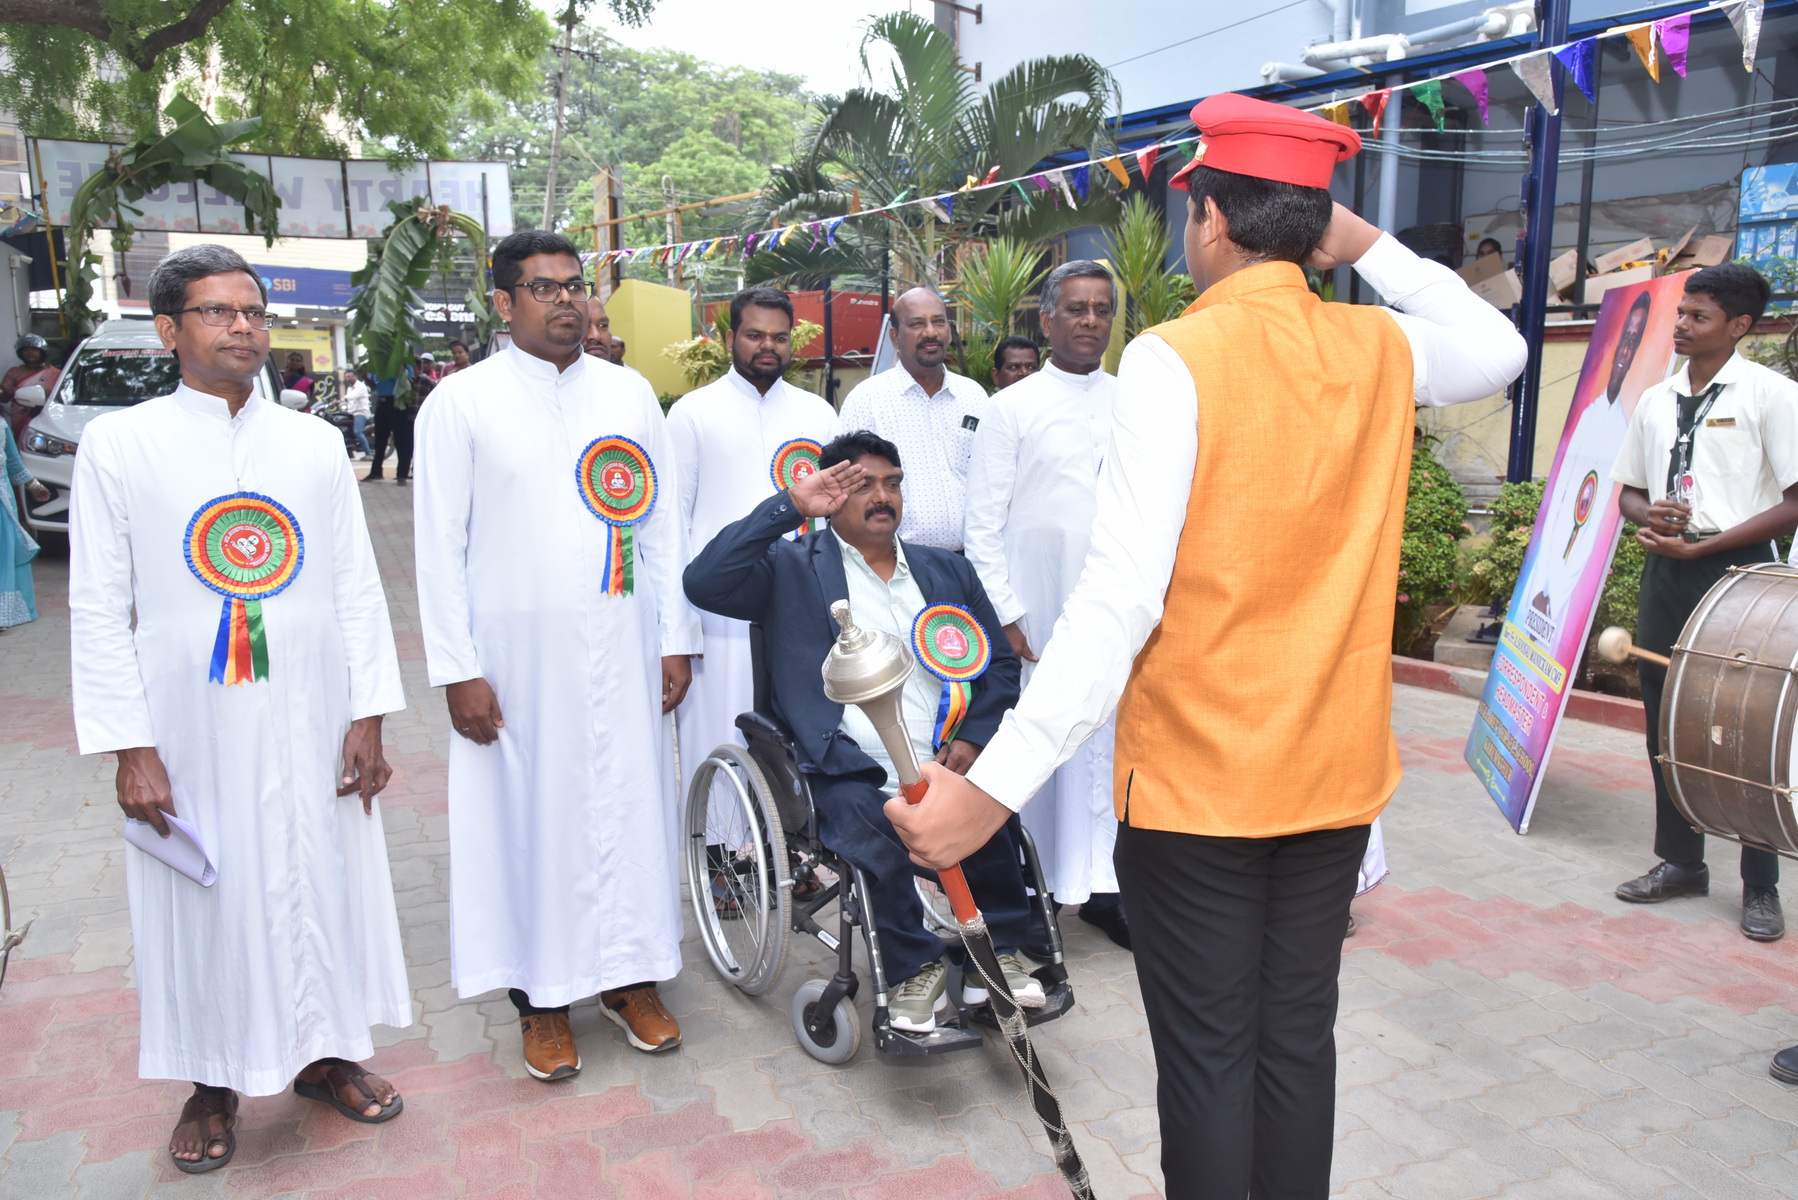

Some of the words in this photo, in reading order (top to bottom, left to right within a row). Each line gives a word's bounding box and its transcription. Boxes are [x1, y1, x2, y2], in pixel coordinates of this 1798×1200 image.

[272, 278, 297, 292] SBI
[1525, 609, 1555, 643] PRESIDENT
[1495, 653, 1546, 713] CORRESPONDENT
[1494, 681, 1534, 735] HEADMASTER
